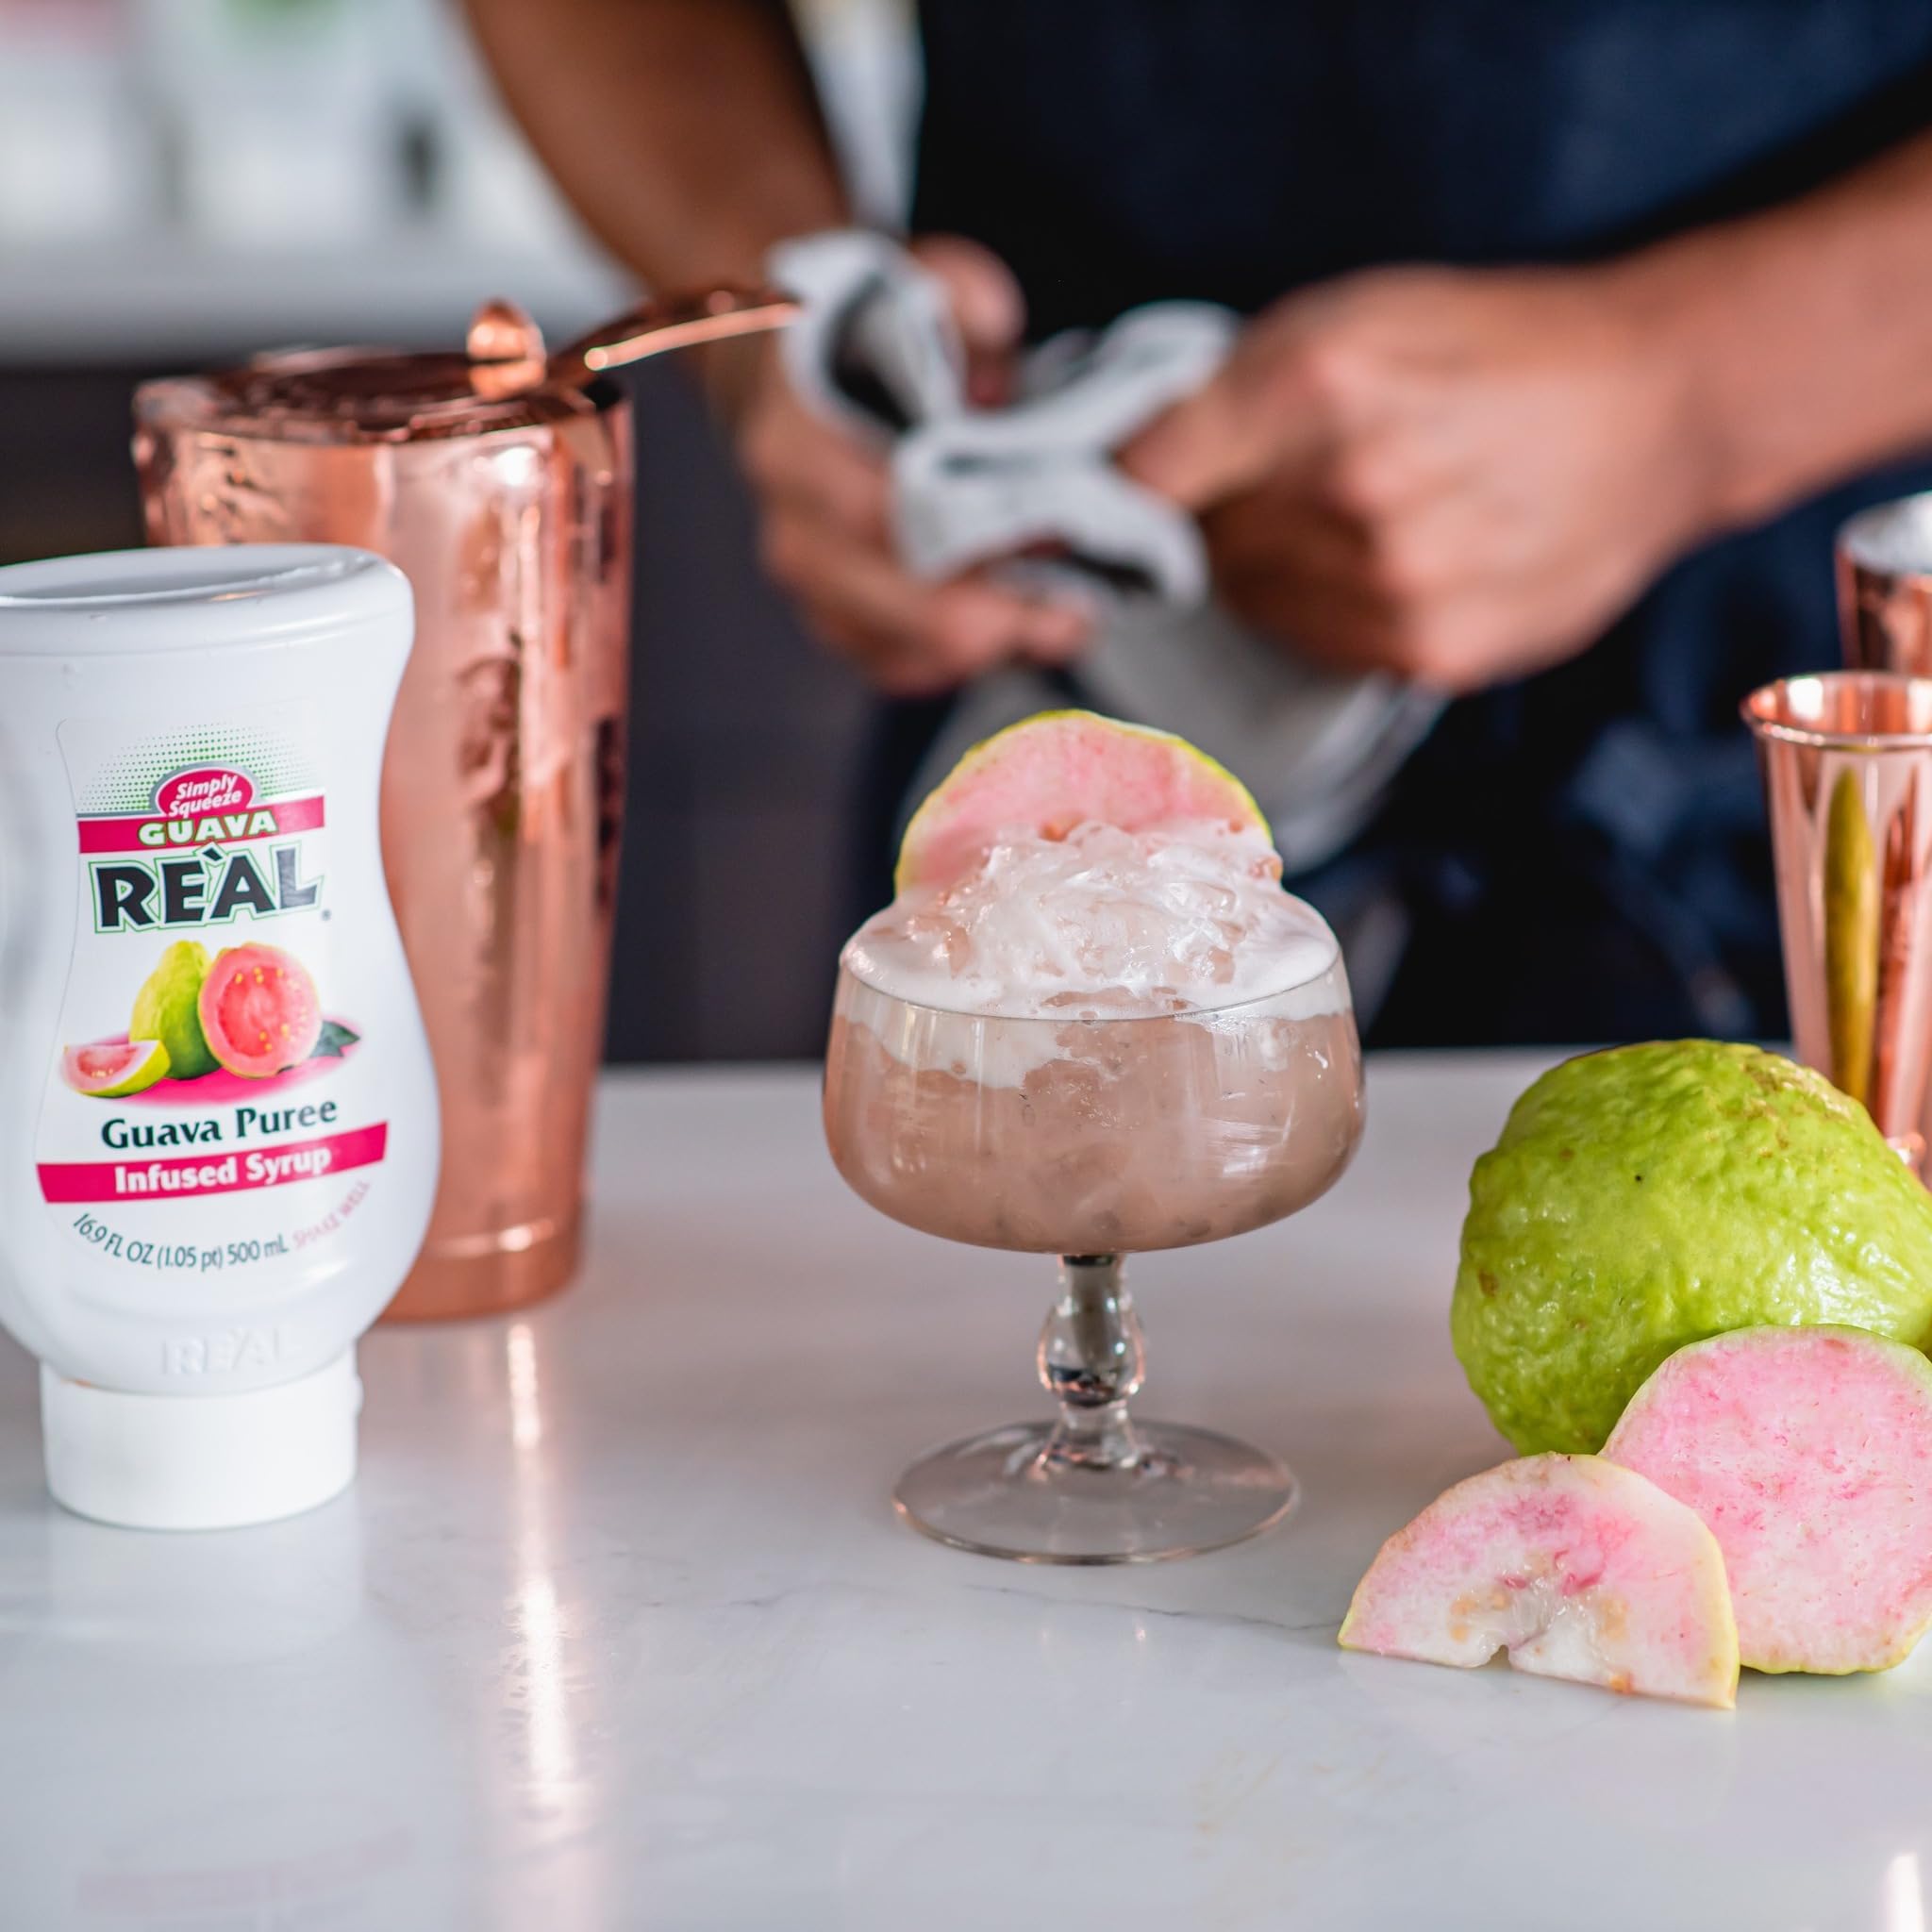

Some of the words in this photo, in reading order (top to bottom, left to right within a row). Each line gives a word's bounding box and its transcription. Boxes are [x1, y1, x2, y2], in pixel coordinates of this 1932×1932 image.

[168, 790, 242, 818] Squeeze
[176, 774, 238, 801] Simply
[138, 809, 278, 846] GUAVA
[101, 1118, 223, 1149] Guava
[235, 1100, 338, 1139] Puree
[114, 1157, 239, 1193] Infused
[245, 1147, 332, 1186] Syrup
[104, 1233, 124, 1257] FL
[126, 1241, 155, 1264] OZ
[157, 1245, 197, 1270] (1.05
[201, 1245, 224, 1273] pt)
[227, 1240, 260, 1265] 500
[263, 1234, 290, 1258] mL
